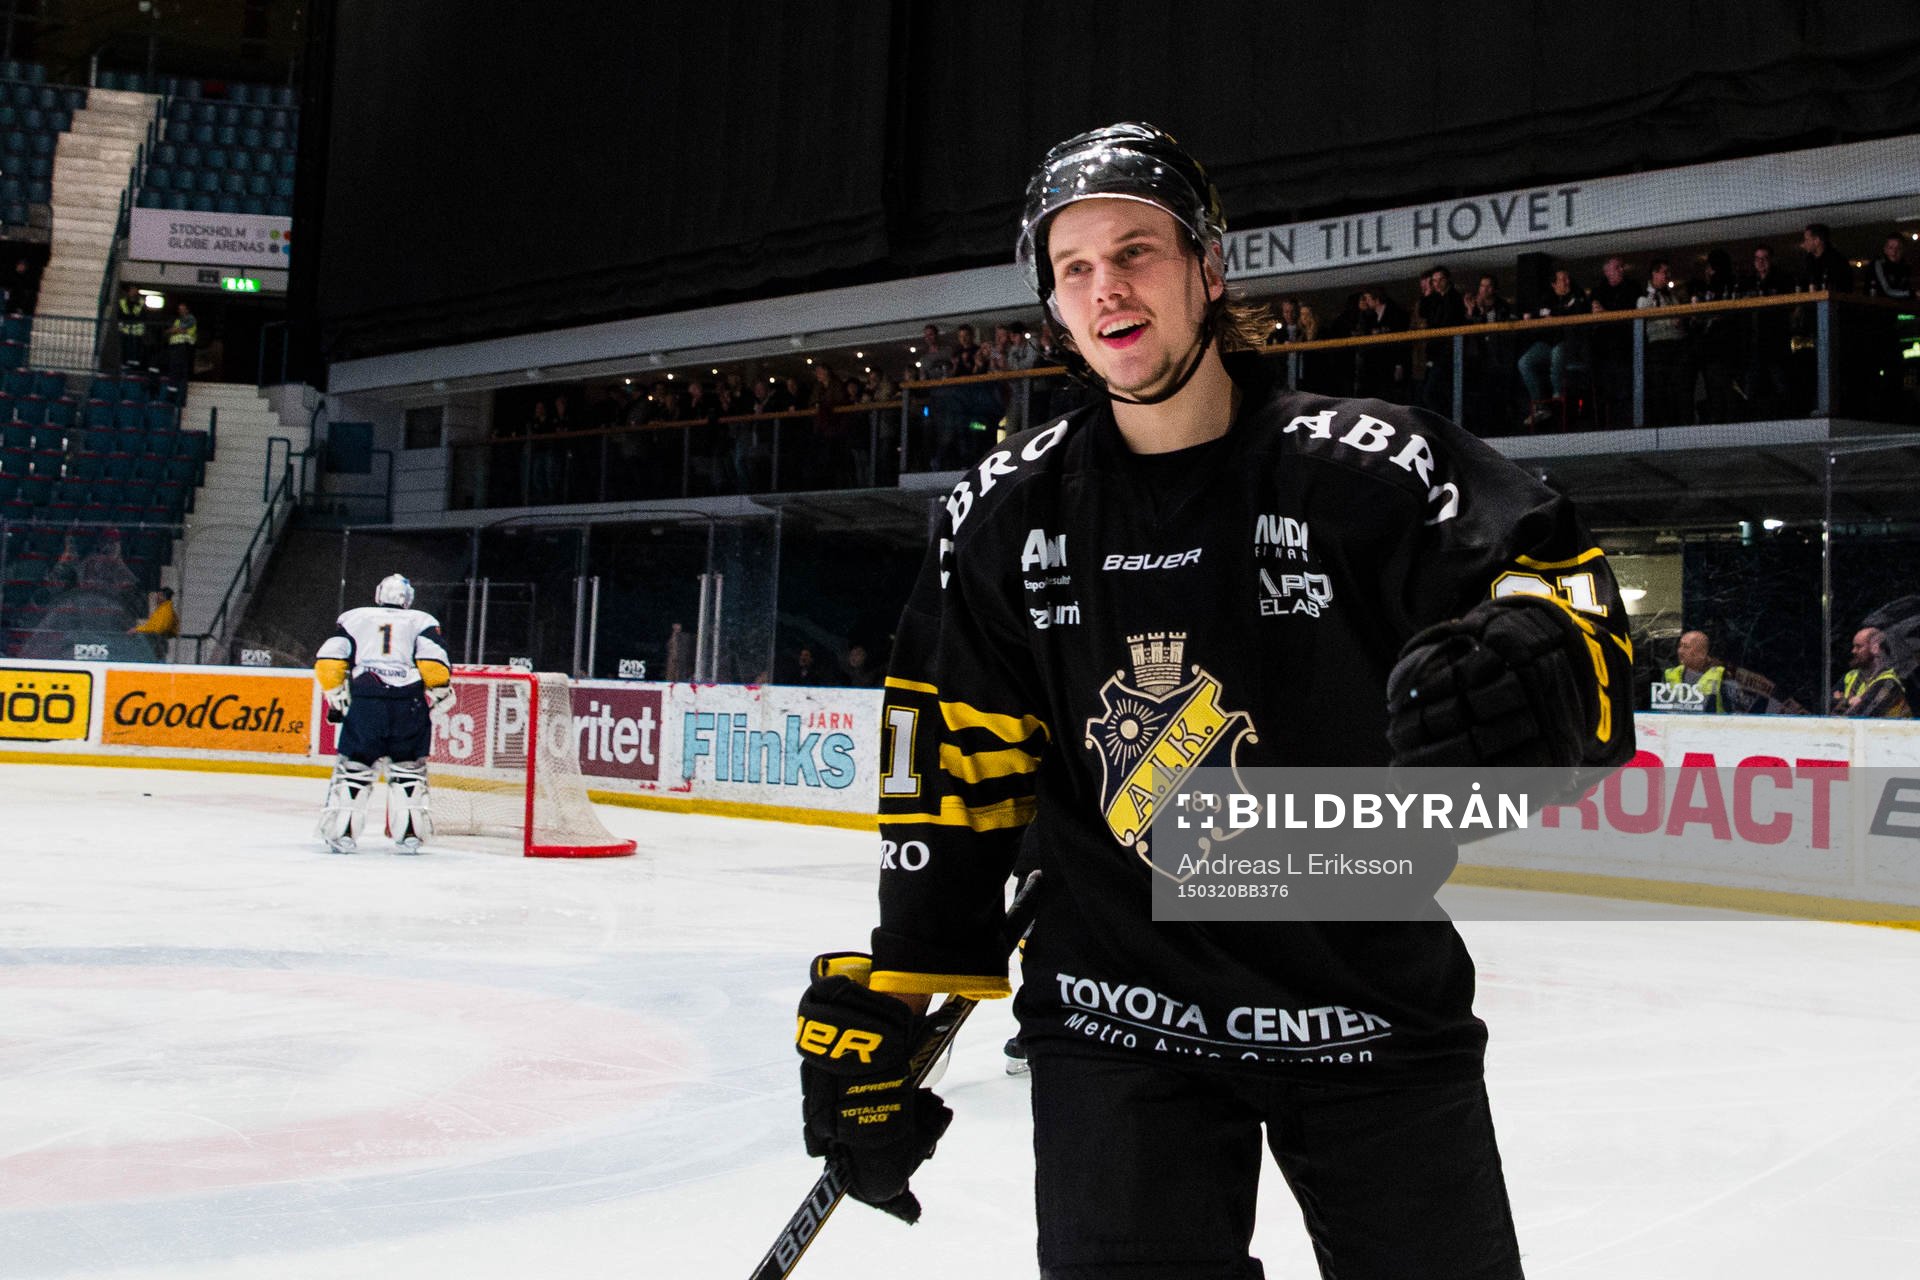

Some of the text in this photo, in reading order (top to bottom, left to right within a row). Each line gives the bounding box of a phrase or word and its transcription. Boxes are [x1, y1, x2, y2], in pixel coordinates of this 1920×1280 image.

[169, 223, 246, 238] STOCKHOLM
[1320, 215, 1391, 260] TILL
[1414, 187, 1581, 248] HOVET
[168, 236, 265, 254] GLOBE ARENAS
[379, 624, 393, 655] 1
[0, 682, 76, 724] ÖÖ
[114, 690, 304, 735] GoodCash.se
[1651, 682, 1705, 704] RYDS
[682, 712, 856, 789] Flinks
[1127, 718, 1213, 825] A.I.K.
[1056, 973, 1392, 1042] TOYOTA CENTER
[1064, 1013, 1137, 1049] Metro
